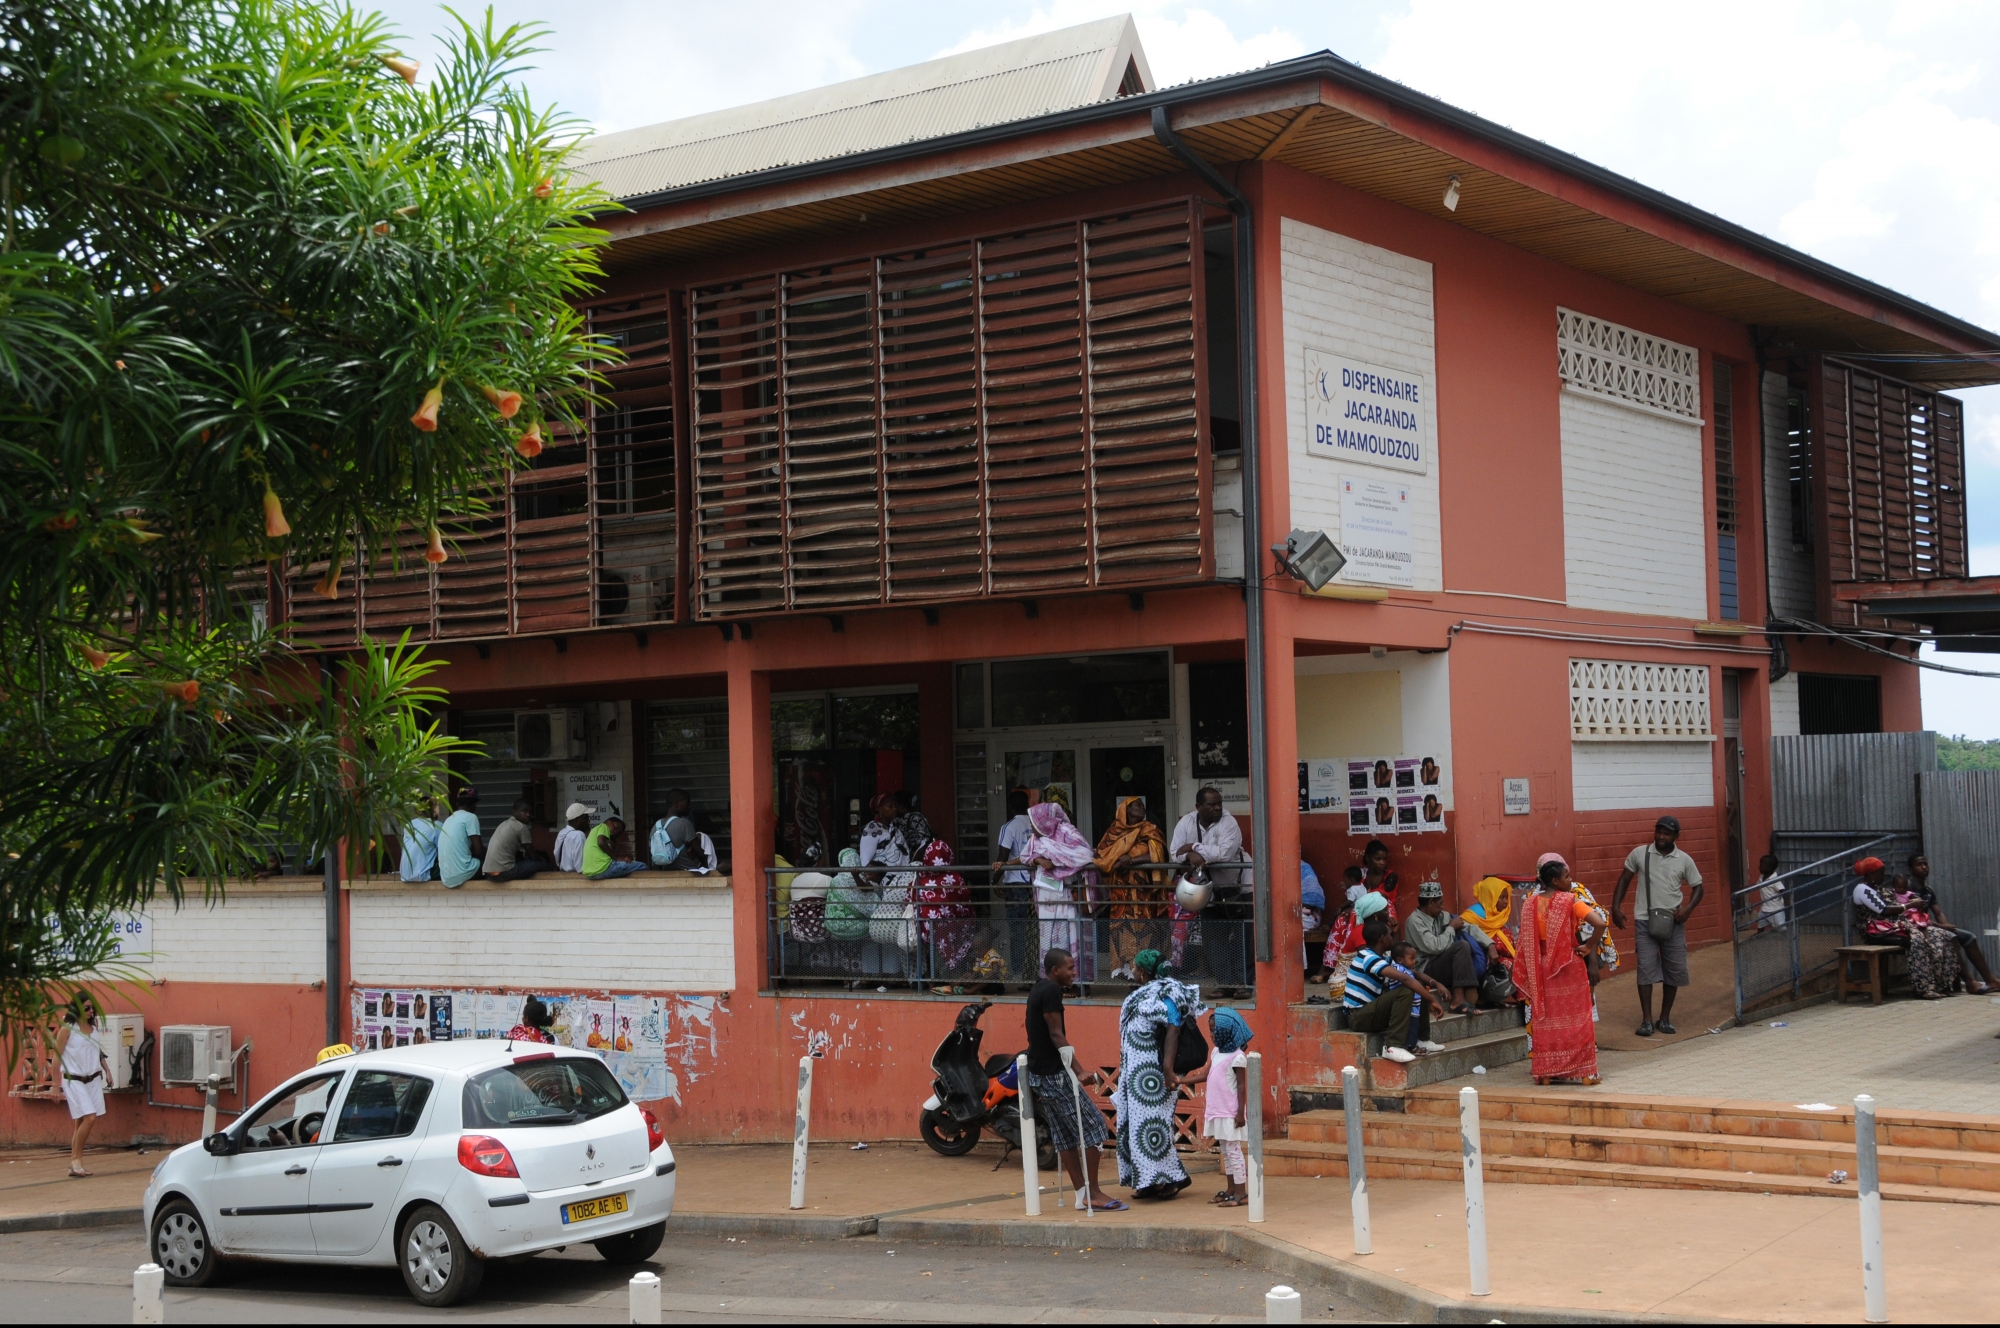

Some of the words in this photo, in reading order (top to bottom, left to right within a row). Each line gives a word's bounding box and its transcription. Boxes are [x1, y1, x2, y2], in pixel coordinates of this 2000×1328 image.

[1342, 367, 1419, 403] DISPENSAIRE
[1344, 399, 1417, 432] JACARANDA
[1316, 424, 1333, 446] DE
[1337, 428, 1419, 462] MAMOUDZOU
[1343, 544, 1351, 556] PMI
[1352, 546, 1358, 556] de
[1359, 547, 1384, 559] JACARANDA
[1385, 550, 1412, 563] MAMOUDZOU
[570, 774, 617, 783] CONSULTATIONS
[1509, 780, 1522, 792] Accès
[577, 783, 610, 792] MÉDICALES
[1506, 794, 1529, 808] Handicapés
[126, 917, 142, 934] de
[324, 1046, 348, 1058] TAXI
[580, 1162, 605, 1172] CLIO
[572, 1202, 596, 1220] 1082
[598, 1199, 610, 1214] AE
